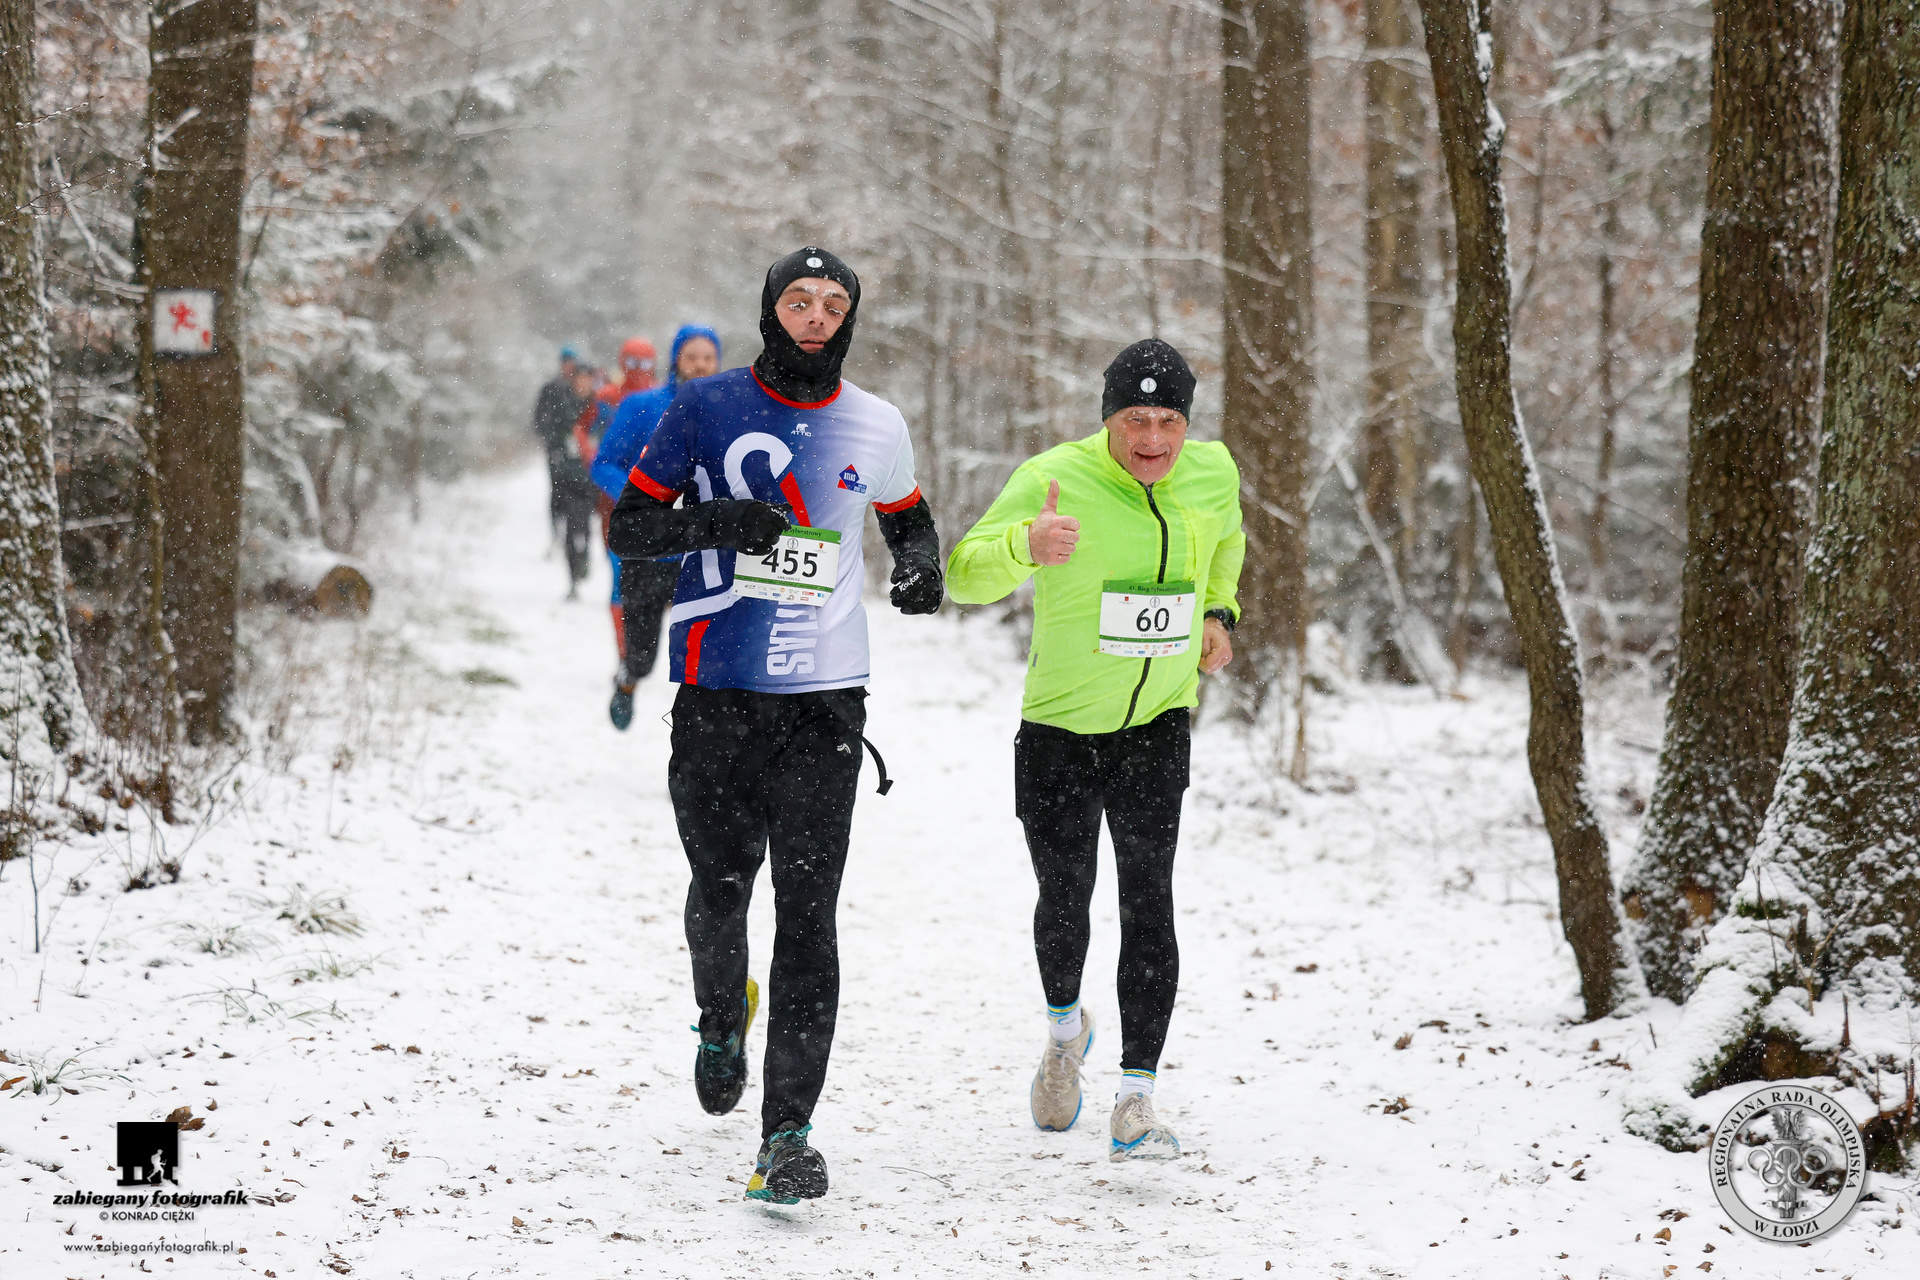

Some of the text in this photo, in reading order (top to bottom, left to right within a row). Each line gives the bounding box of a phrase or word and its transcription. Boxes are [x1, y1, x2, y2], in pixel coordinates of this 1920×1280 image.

[761, 547, 818, 578] 455
[1136, 607, 1170, 632] 60
[767, 600, 818, 676] TLAS
